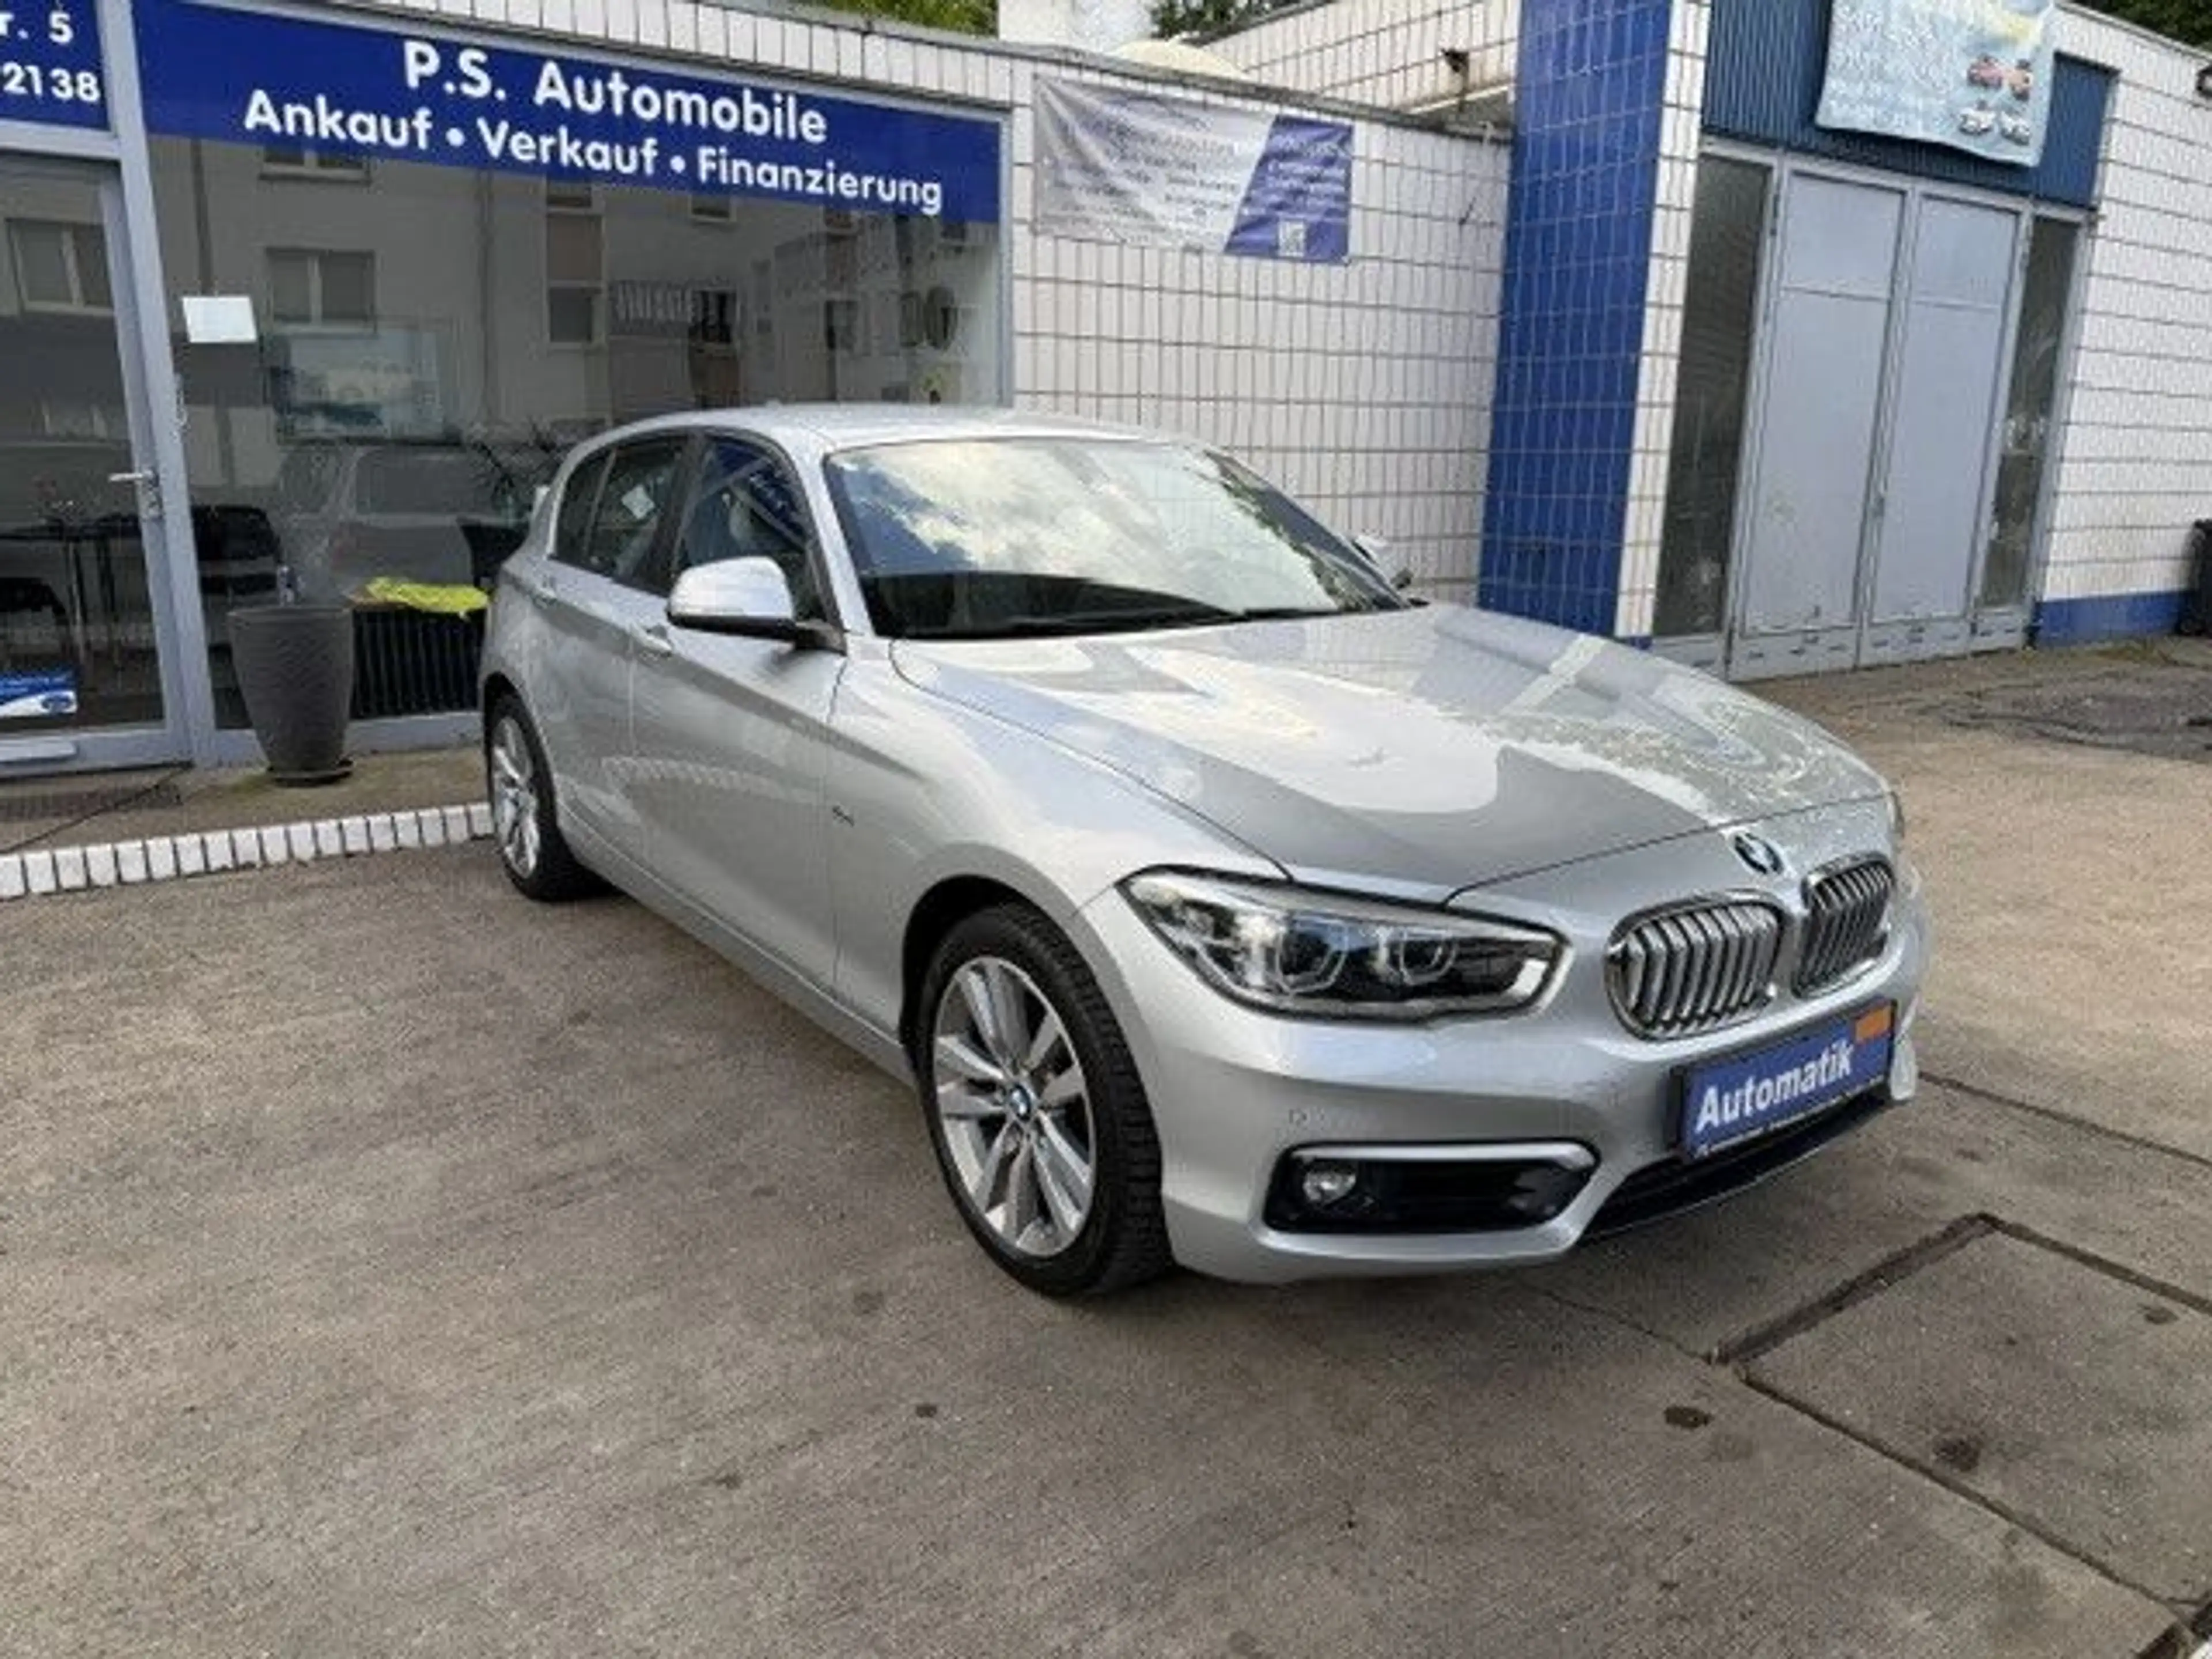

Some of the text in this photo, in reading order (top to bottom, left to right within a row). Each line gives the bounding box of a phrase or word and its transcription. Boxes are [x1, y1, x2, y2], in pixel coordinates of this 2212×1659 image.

[49, 10, 74, 44] 5
[2, 62, 101, 103] 2138
[404, 40, 827, 144] P.S. Automobile
[244, 89, 942, 217] Ankauf Verkauf Finanzierung
[1694, 1037, 1855, 1134] Automatik
